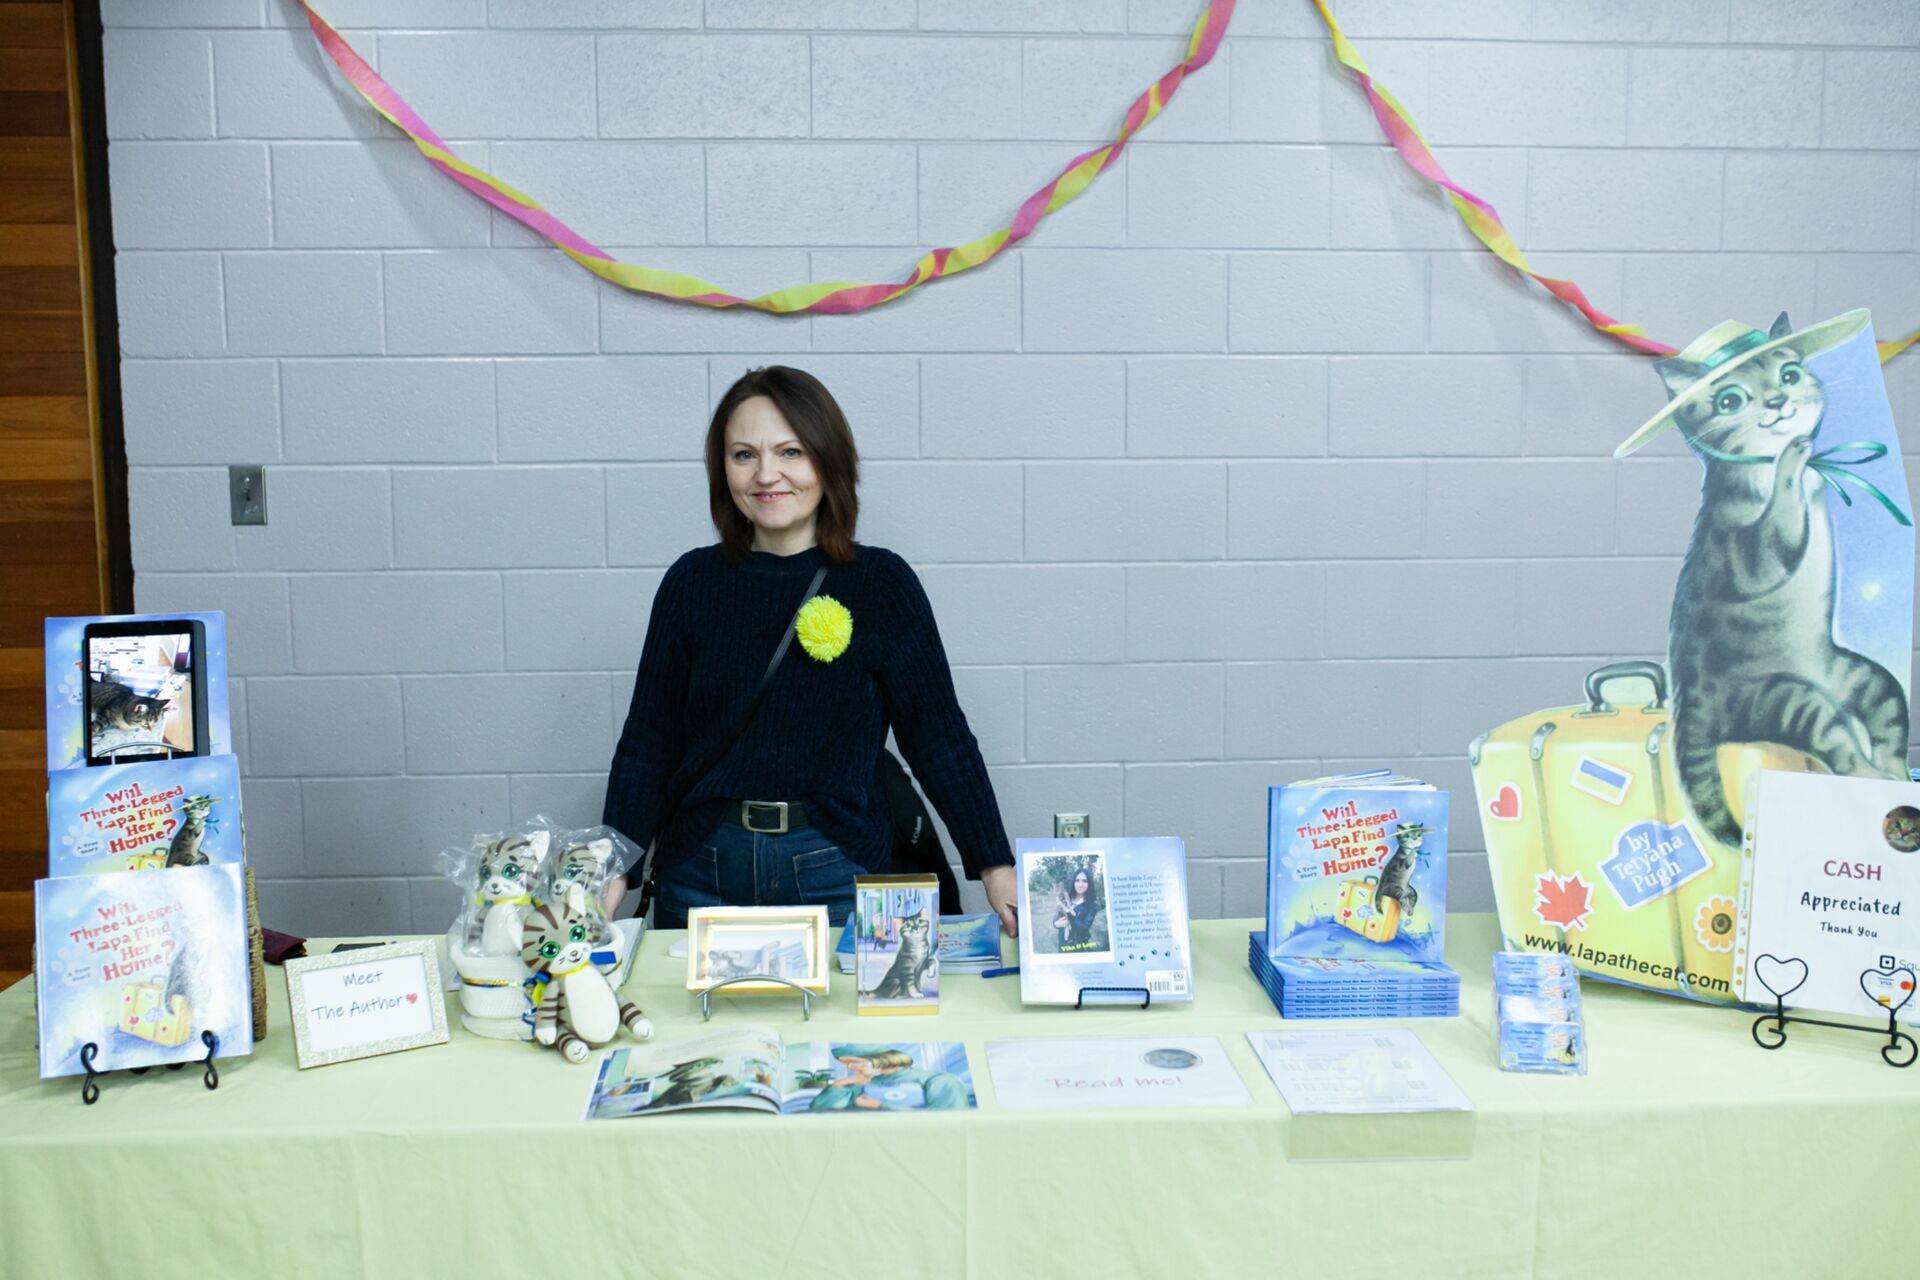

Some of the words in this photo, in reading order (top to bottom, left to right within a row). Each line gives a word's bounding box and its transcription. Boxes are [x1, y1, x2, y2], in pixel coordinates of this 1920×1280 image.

[80, 785, 184, 822] Three-Legged
[105, 783, 142, 804] Will
[96, 814, 136, 831] Lapa
[138, 803, 173, 821] Find
[1297, 808, 1398, 838] Three-Legged
[1322, 801, 1358, 820] Will
[109, 819, 177, 854] Home?
[125, 821, 155, 837] Her
[1312, 835, 1350, 849] Lapa
[1351, 828, 1386, 843] Find
[1625, 831, 1651, 852] by
[1323, 845, 1389, 876] Home?
[1339, 846, 1368, 859] Her
[1611, 835, 1685, 881] Tetyana
[1631, 860, 1682, 894] Pugh
[1823, 860, 1882, 881] CASH
[97, 902, 138, 920] Will
[1800, 891, 1902, 916] Appreciated
[70, 901, 182, 943] Three-Legged
[1820, 921, 1853, 935] Thank
[1857, 926, 1878, 938] You
[87, 934, 132, 952] Lapa
[133, 921, 171, 941] Find
[103, 940, 175, 981] Home?
[120, 944, 152, 961] Her
[1525, 933, 1730, 993] www.lapathecat.com
[343, 970, 383, 987] Meet
[312, 1005, 344, 1020] The
[350, 995, 403, 1016] Author
[1047, 1076, 1123, 1089] Read
